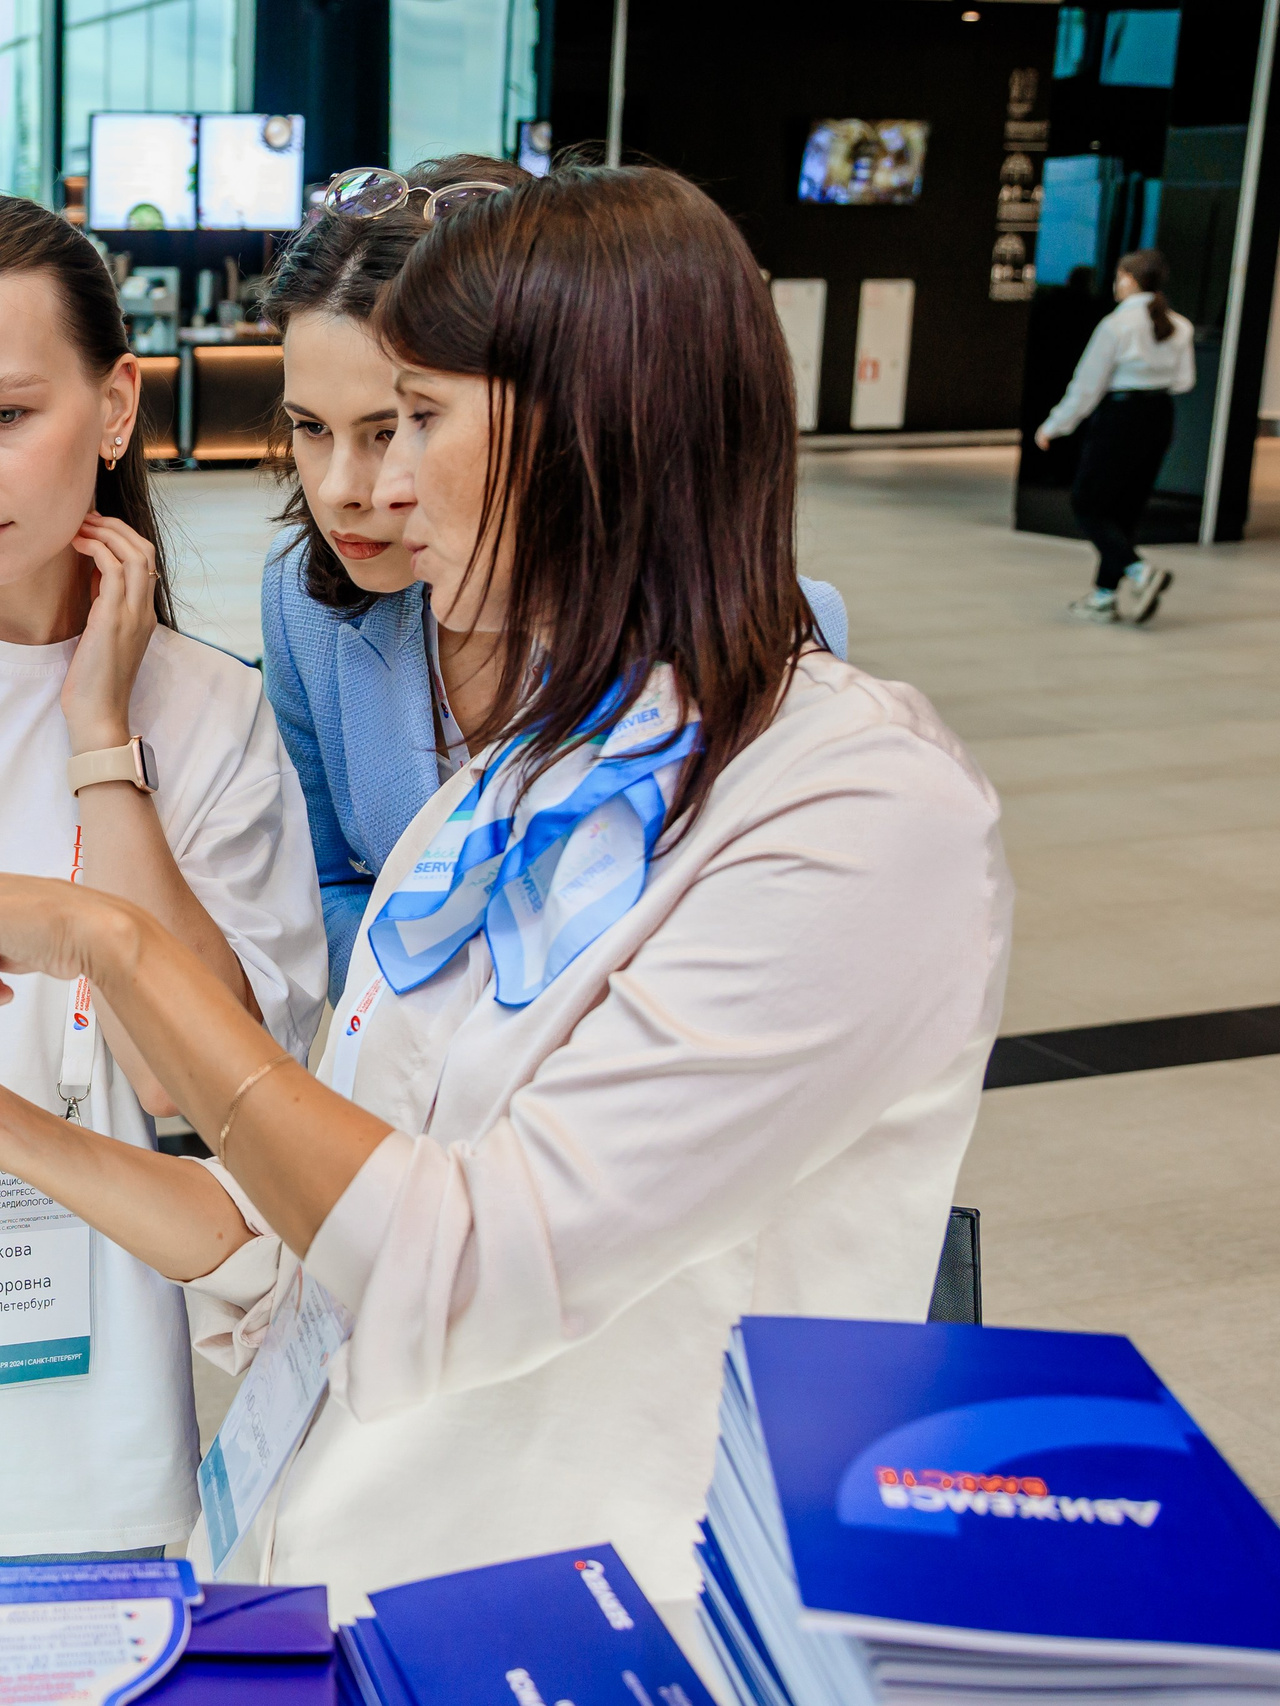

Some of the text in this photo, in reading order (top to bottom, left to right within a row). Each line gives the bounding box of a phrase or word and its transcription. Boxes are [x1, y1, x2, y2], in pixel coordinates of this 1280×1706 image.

[9, 1358, 24, 1368] 2024
[27, 1353, 83, 1366] САНКТ-ПЕТЕРБУРГ
[880, 1484, 1162, 1529] ДВИЖЕМСЯ
